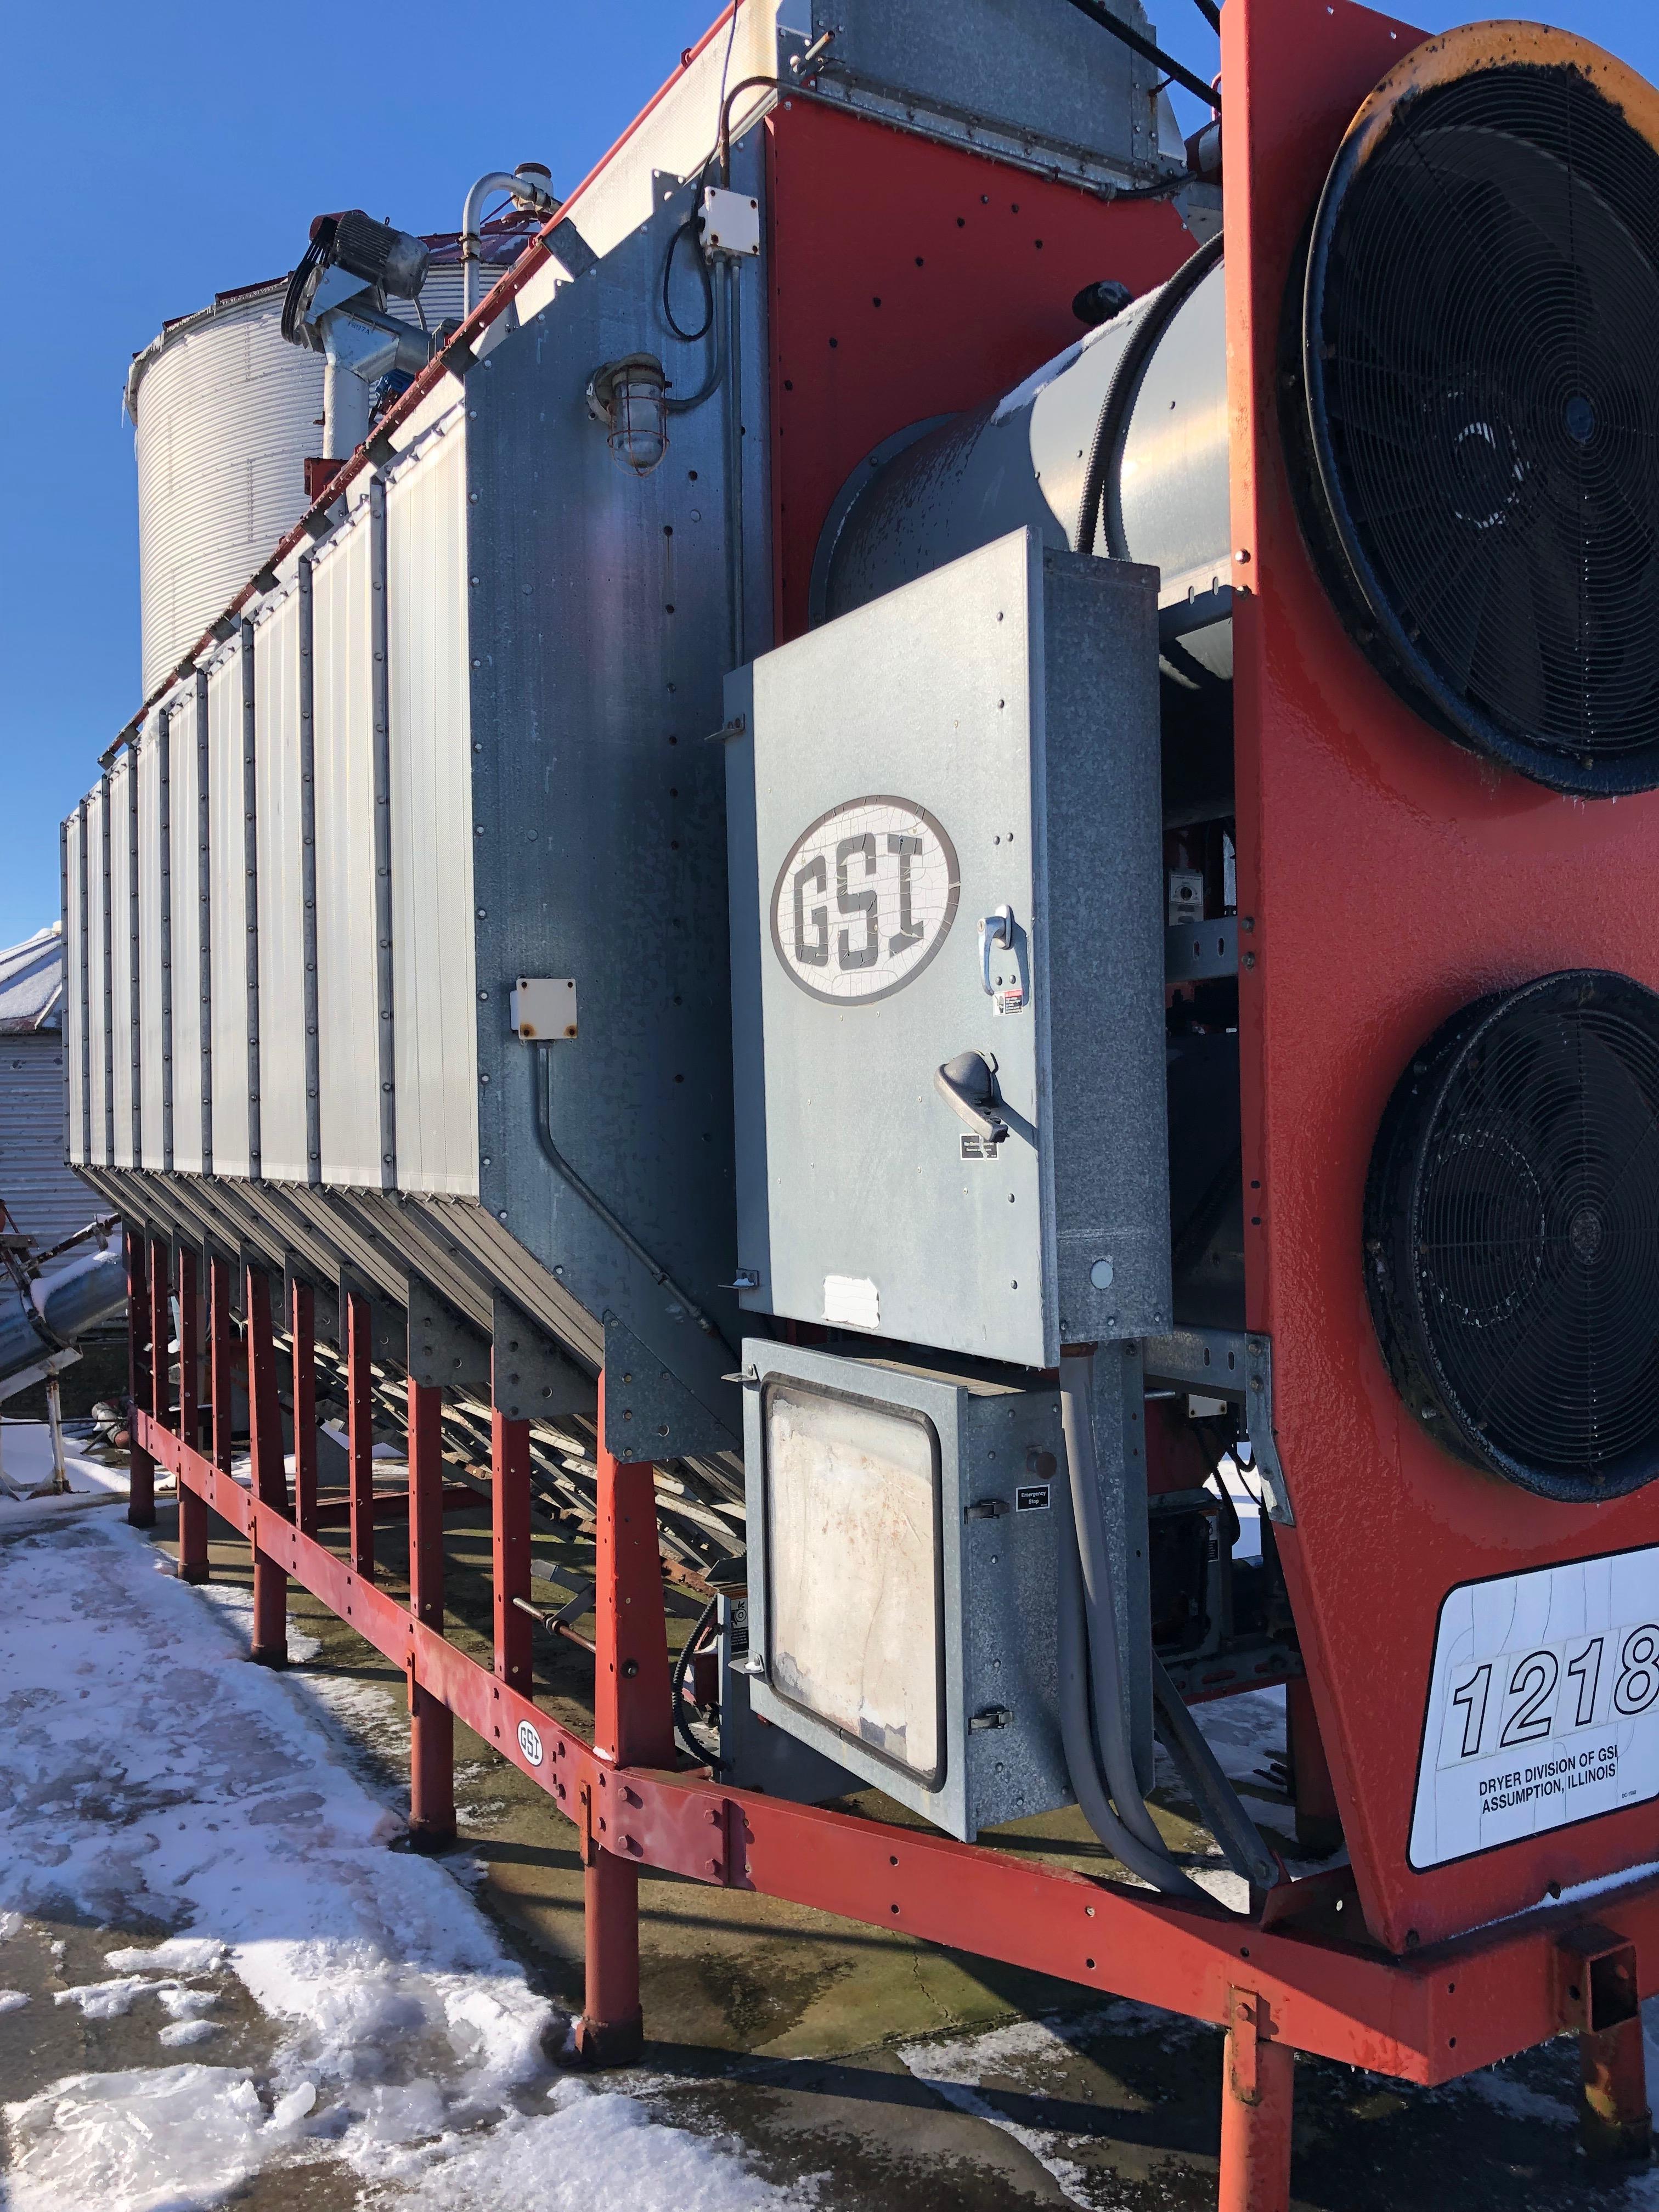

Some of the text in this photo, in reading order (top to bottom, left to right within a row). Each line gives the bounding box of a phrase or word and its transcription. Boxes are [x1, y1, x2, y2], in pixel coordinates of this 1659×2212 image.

[793, 832, 924, 970] GSI
[1453, 1624, 1659, 1758] 1218
[521, 1727, 539, 1759] GSI
[1479, 1745, 1618, 1796] DRYER DIVISION OF GSI
[1482, 1763, 1616, 1814] ASSUMPTION, ILLINOIS
